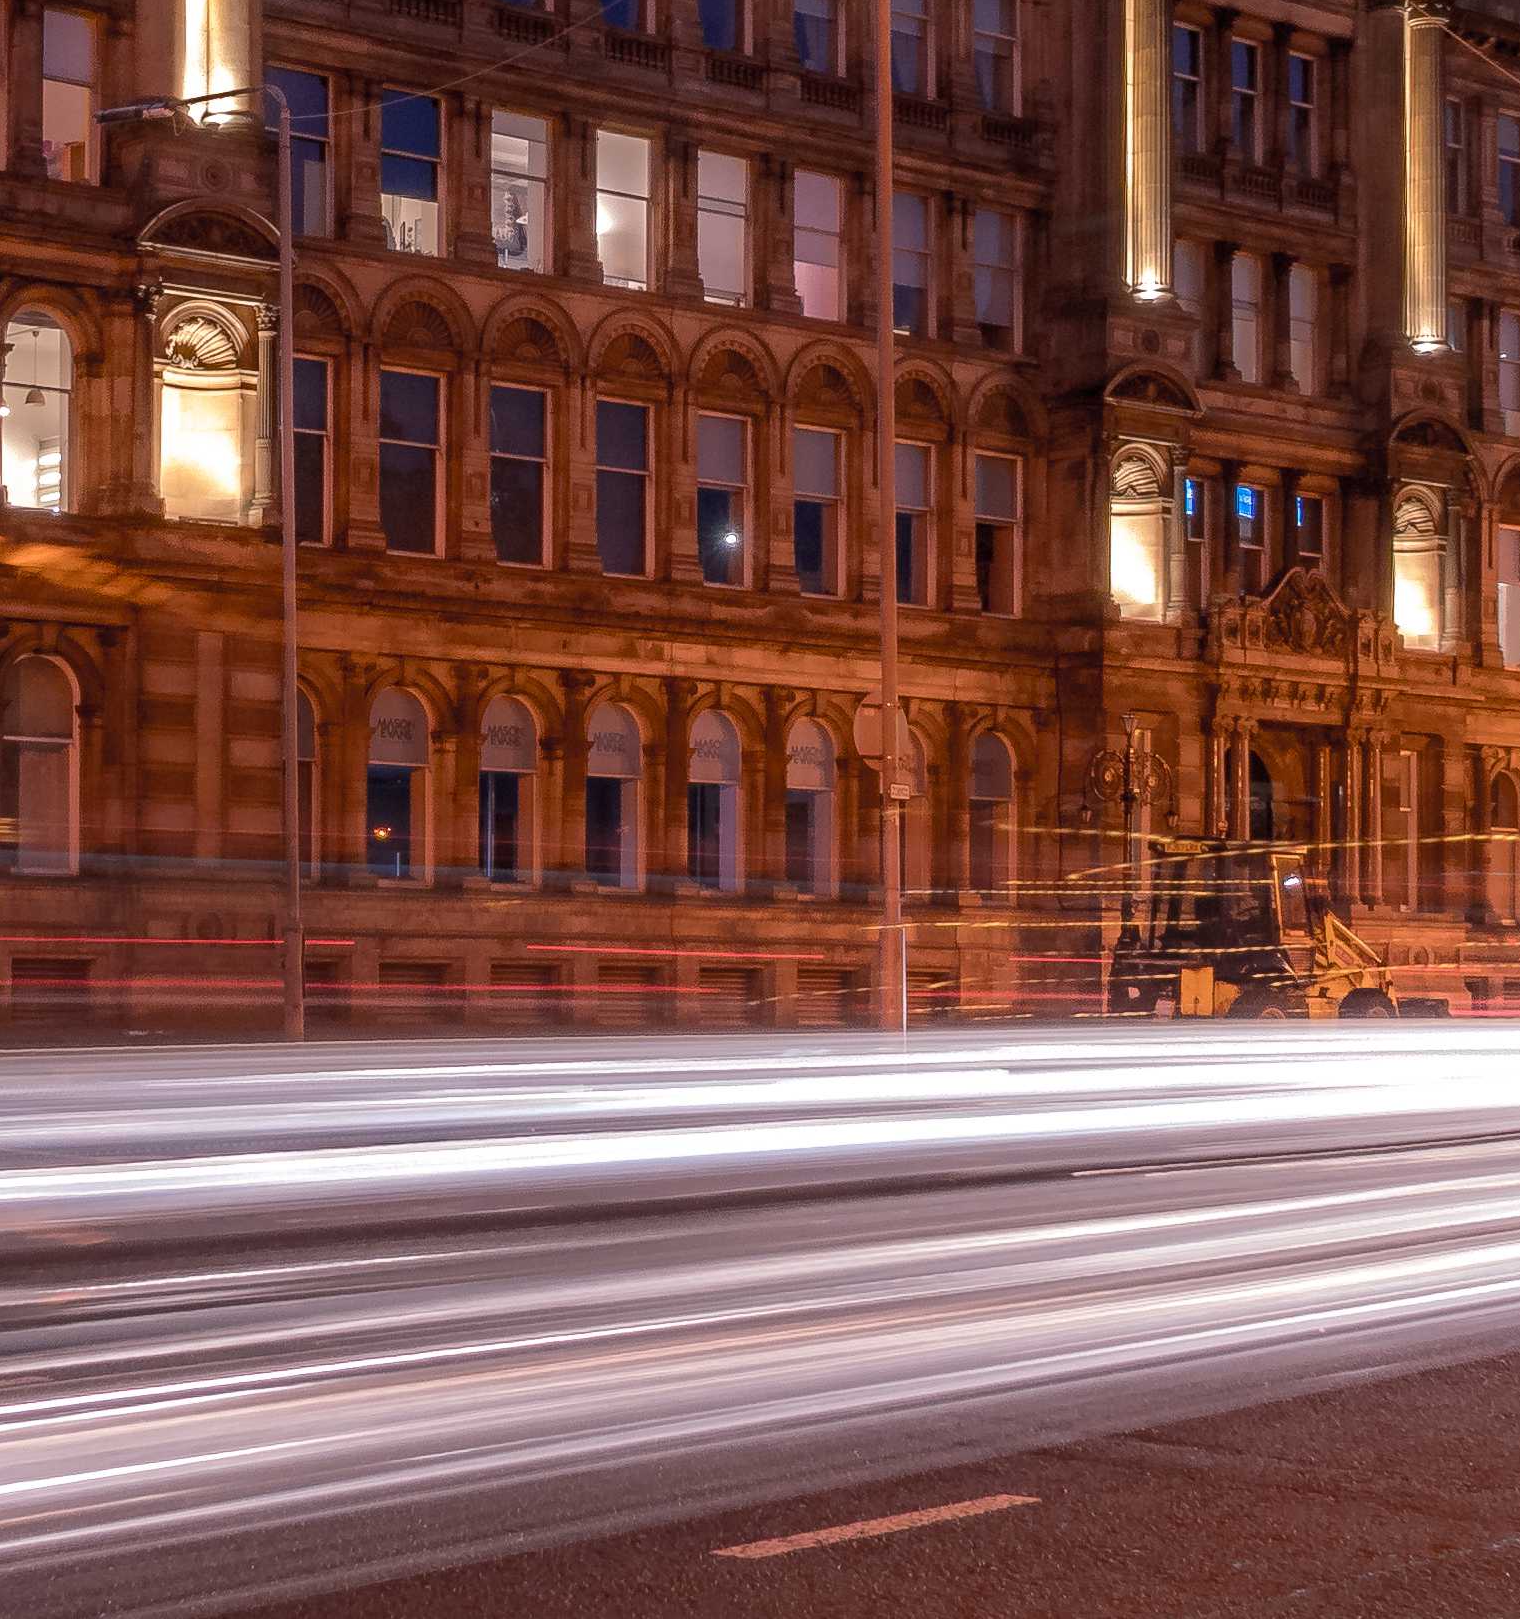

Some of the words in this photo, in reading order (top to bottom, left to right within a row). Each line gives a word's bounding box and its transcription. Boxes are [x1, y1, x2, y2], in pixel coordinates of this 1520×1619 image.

[378, 718, 415, 731] MASON
[381, 730, 413, 741] EVANS
[487, 725, 523, 736] MASON
